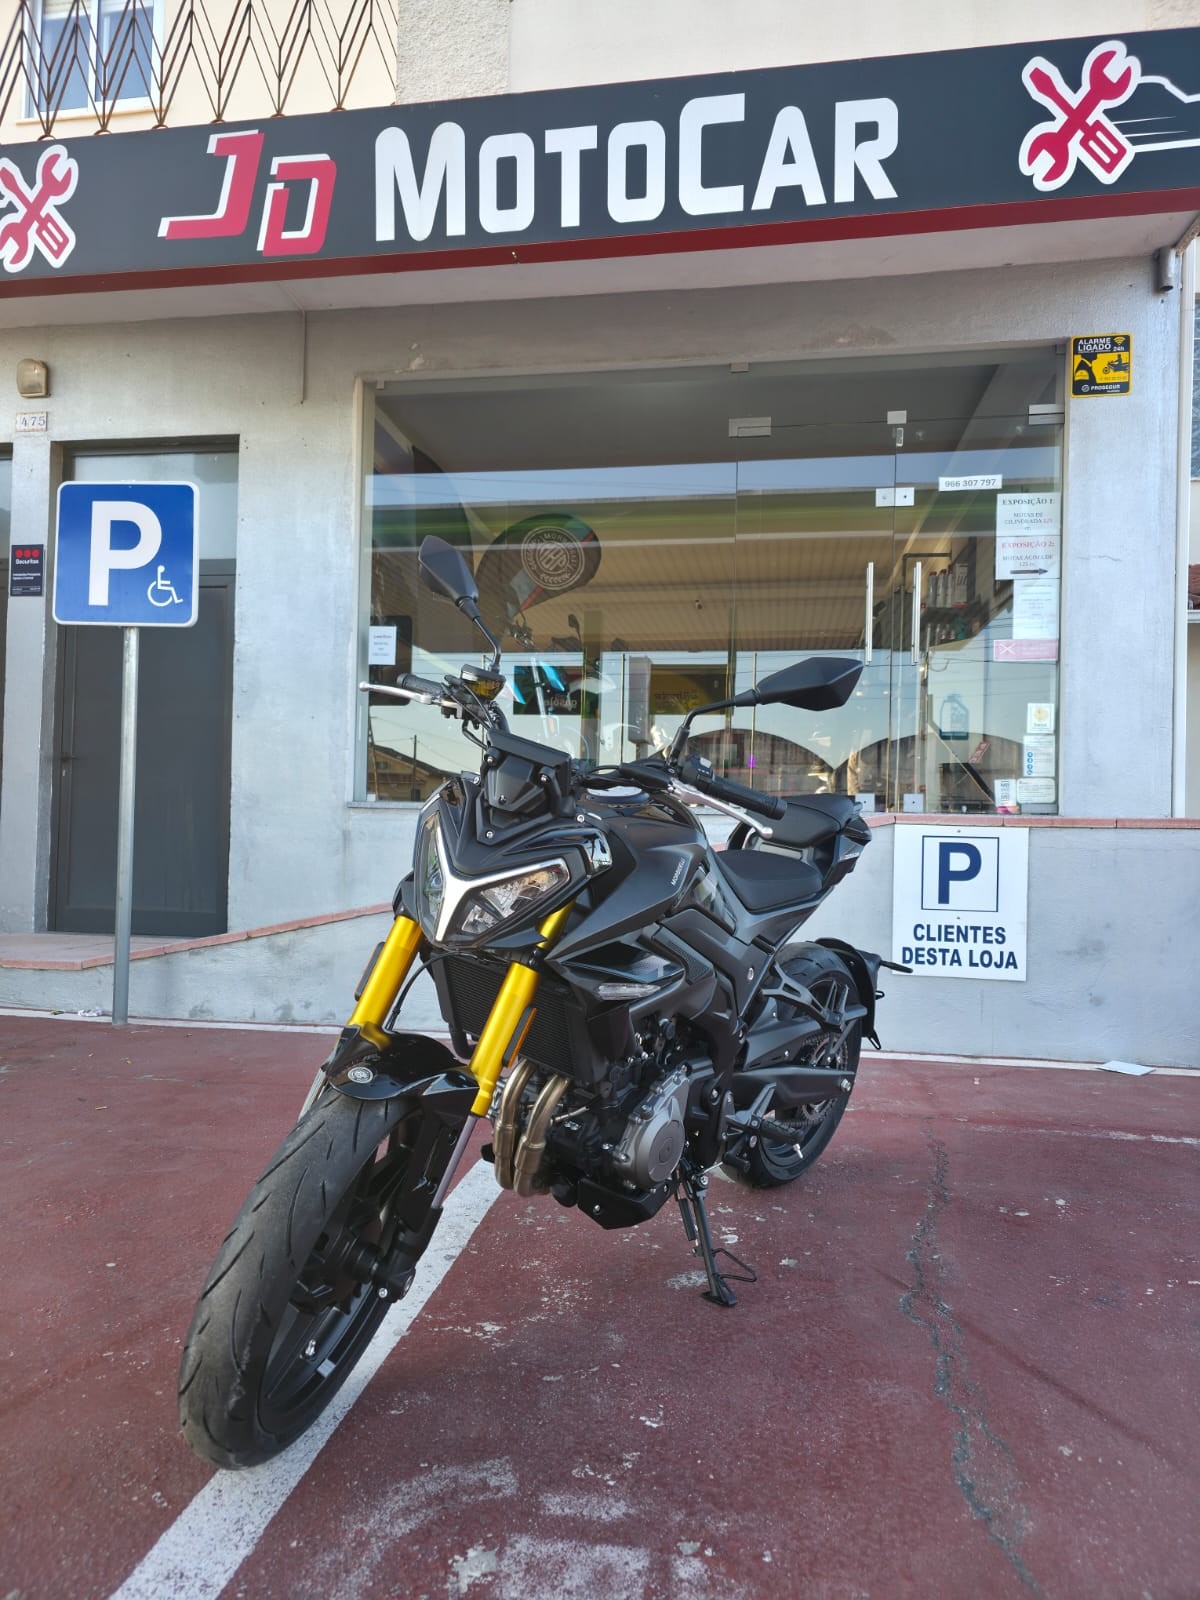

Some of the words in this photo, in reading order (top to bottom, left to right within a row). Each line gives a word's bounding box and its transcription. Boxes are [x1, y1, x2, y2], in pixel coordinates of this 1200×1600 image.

[1078, 337, 1111, 345] ALARME
[1078, 343, 1111, 352] LIGADO
[21, 415, 46, 427] 475
[962, 479, 979, 487] 307
[980, 478, 997, 487] 797
[1001, 497, 1047, 505] EXPOSIÇÃO
[88, 500, 162, 606] P
[938, 842, 982, 904] P
[913, 923, 1006, 945] CLIENTES
[902, 946, 962, 967] DESTA
[968, 949, 1018, 969] LOJA
